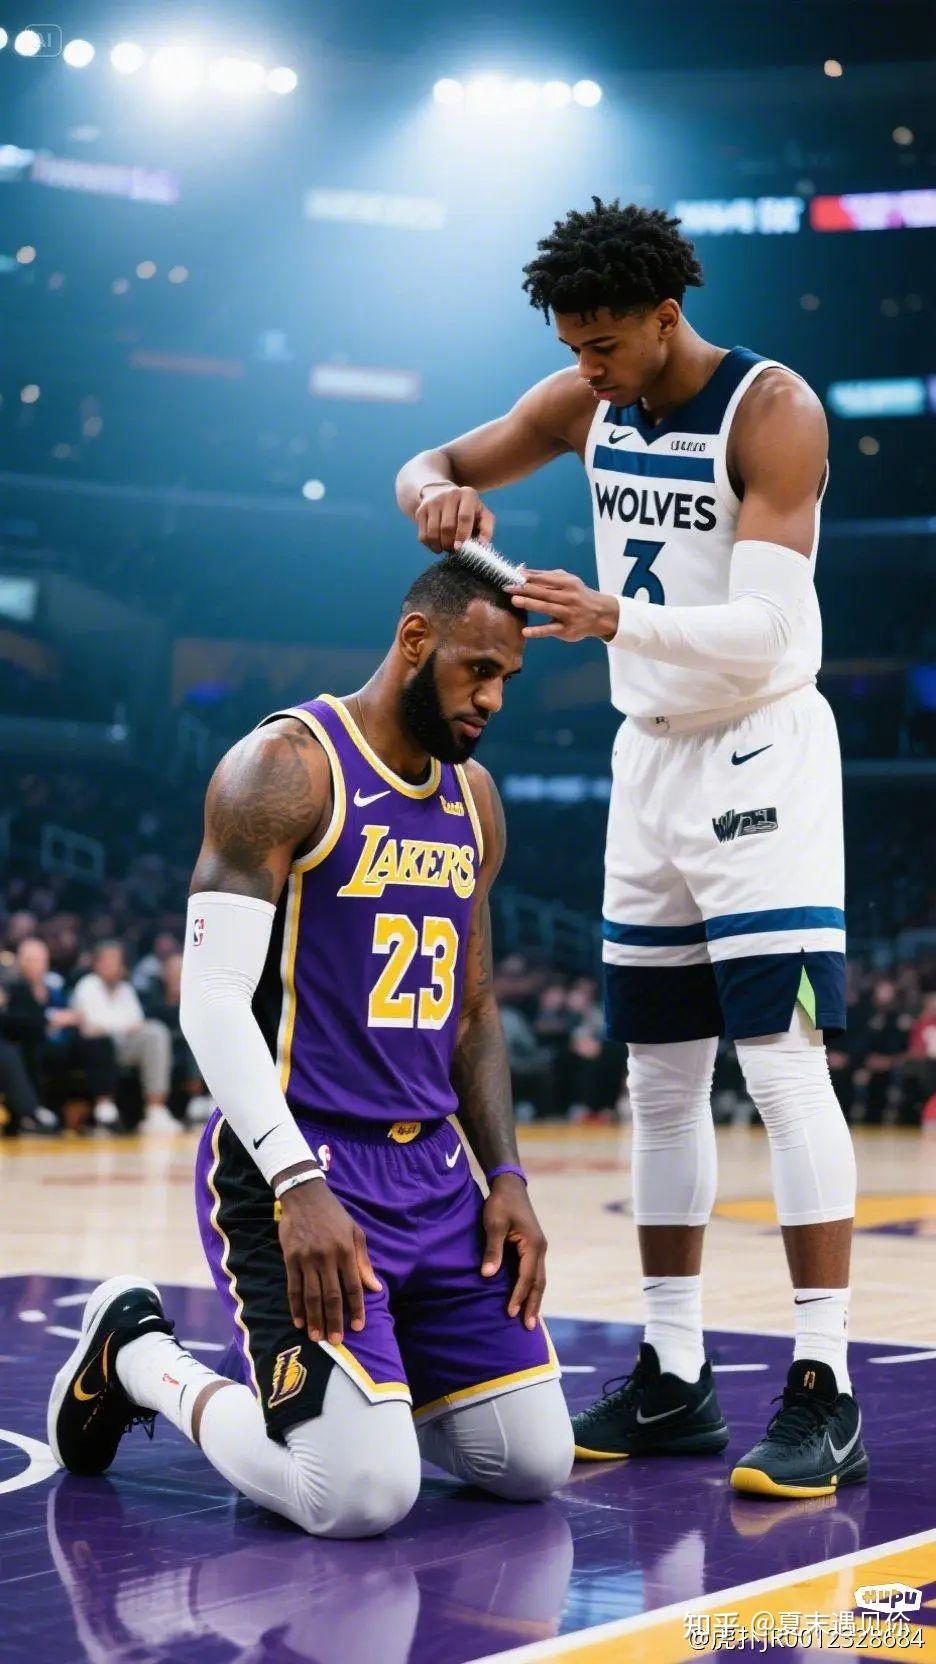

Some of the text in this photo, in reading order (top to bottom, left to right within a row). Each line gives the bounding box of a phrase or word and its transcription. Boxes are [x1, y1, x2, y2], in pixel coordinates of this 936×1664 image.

[595, 482, 717, 532] WOLVES
[337, 824, 476, 898] LAKERS
[367, 913, 459, 1030] 23
